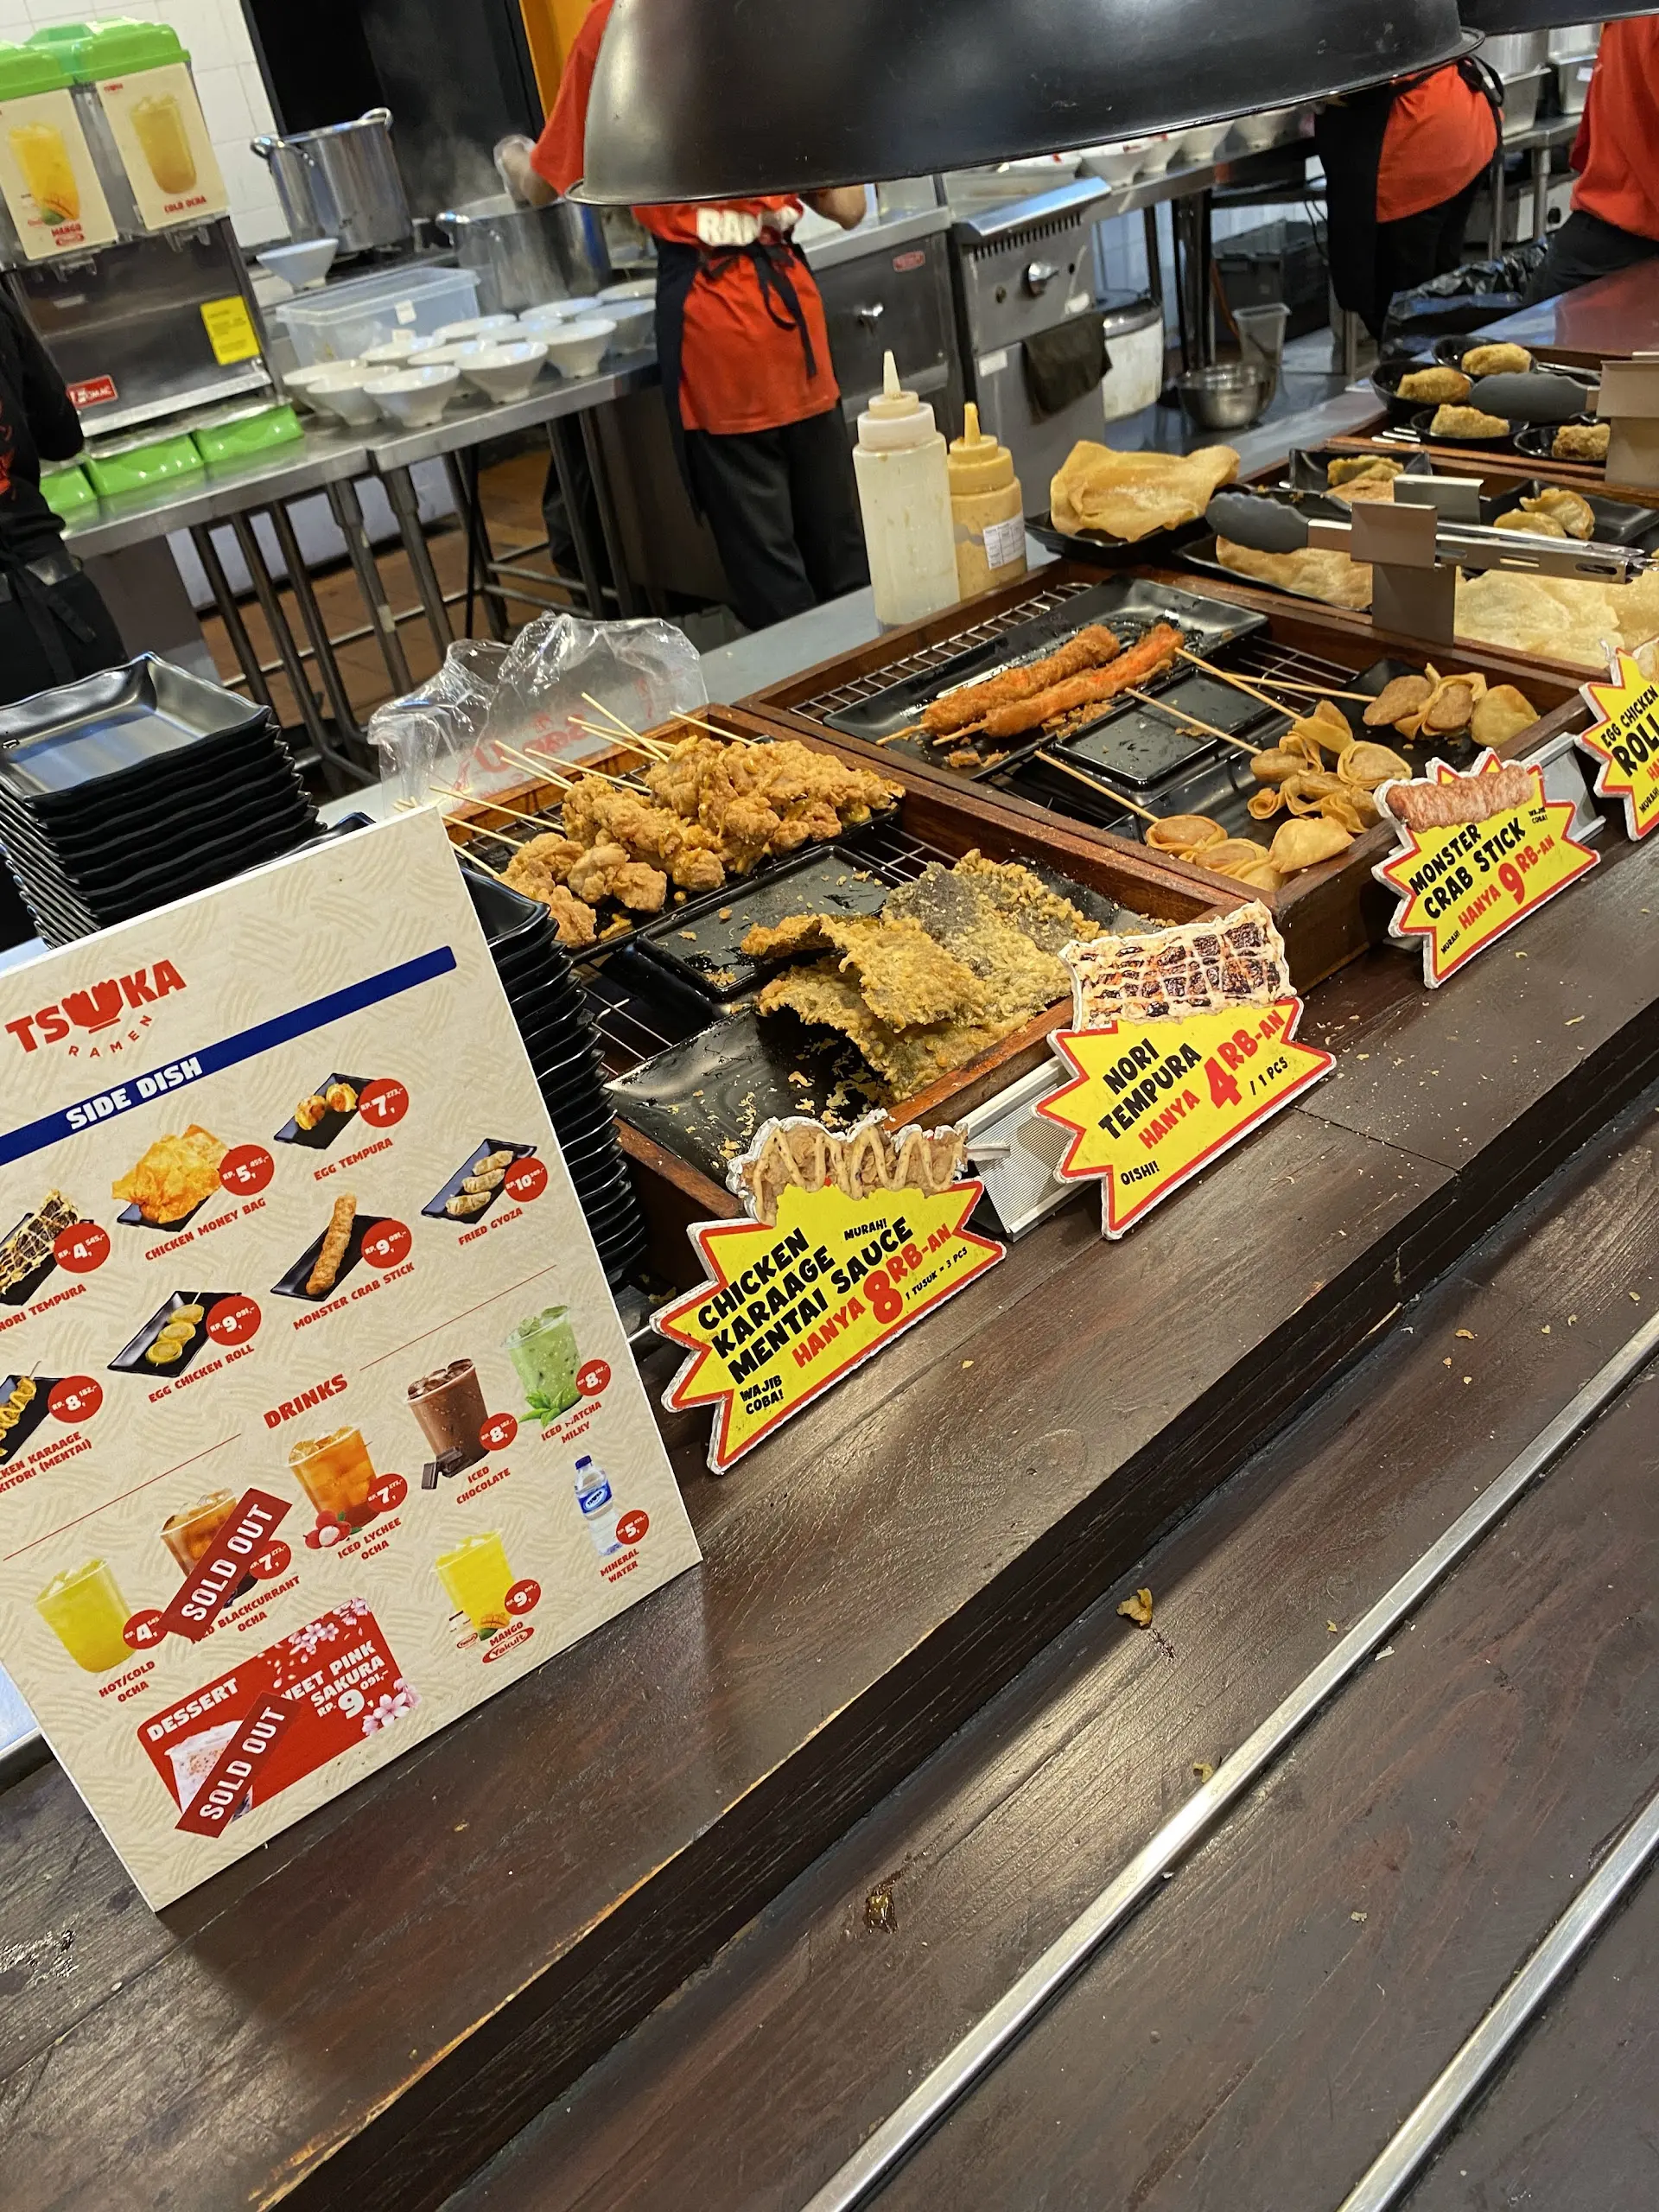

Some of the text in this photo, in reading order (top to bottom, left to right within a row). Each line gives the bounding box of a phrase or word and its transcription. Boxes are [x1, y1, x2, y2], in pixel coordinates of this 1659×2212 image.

[1600, 722, 1622, 749] EGG
[1620, 684, 1659, 728] CHICKEN
[1408, 823, 1482, 897] MONSTER
[1424, 817, 1526, 919] CRAB STICK
[1458, 883, 1502, 931] HANYA
[1440, 930, 1460, 955] MURAH!
[5, 958, 187, 1053] TSUKA
[68, 1014, 153, 1058] RAMEN
[1103, 1038, 1160, 1096] NORI
[1267, 1056, 1288, 1082] PCS
[66, 1057, 203, 1130] SIDE DISH
[1097, 1042, 1203, 1140] TEMPURA
[1137, 1089, 1200, 1150] HANYA
[314, 1137, 394, 1181] EGG TEMPURA
[1119, 1160, 1160, 1186] OISHI!
[145, 1198, 267, 1262] CHICKEN MONEY BAG
[458, 1208, 524, 1246] FRIED GYOZA
[843, 1217, 888, 1242] MURAH!
[697, 1227, 810, 1331] CHICKEN
[912, 1270, 938, 1295] TUSUK
[945, 1259, 952, 1268] 3
[952, 1246, 968, 1263] PCS
[0, 1284, 86, 1331] NORI TEMPURA
[294, 1262, 415, 1330] MONSTER CRAB STICK
[711, 1245, 837, 1360] KARAAGE
[727, 1216, 914, 1385] MENTAI SAUCE
[791, 1296, 867, 1369] HANYA
[148, 1344, 255, 1403] EGG CHICKEN ROLL
[739, 1373, 783, 1403] WAJIB
[263, 1374, 348, 1429] DRINKS
[745, 1388, 785, 1415] COBA!
[28, 1431, 81, 1464] KARAAGE
[541, 1424, 563, 1441] ICED
[561, 1421, 590, 1444] MILKY
[39, 1439, 92, 1472] (MENTAI)
[467, 1466, 490, 1484] ICED
[456, 1467, 511, 1504] CHOCOLATE
[337, 1517, 402, 1560] ICED LYCHEE
[361, 1540, 390, 1560] OCHA
[181, 1559, 238, 1622] SOLD
[226, 1503, 273, 1554] OUT
[600, 1548, 639, 1577] MINERAL
[608, 1560, 639, 1583] WATER
[217, 1575, 301, 1629] BLACKCURRANT
[237, 1611, 268, 1632] OCHA
[489, 1621, 524, 1647] MANGO
[493, 1633, 527, 1656] Yakult
[99, 1661, 156, 1698] HOT/COLD
[329, 1639, 377, 1677] PINK
[118, 1681, 149, 1703] OCHA
[310, 1655, 385, 1707] SAKURA
[146, 1677, 238, 1742] DESSERT
[199, 1707, 285, 1820] SOLD OUT
